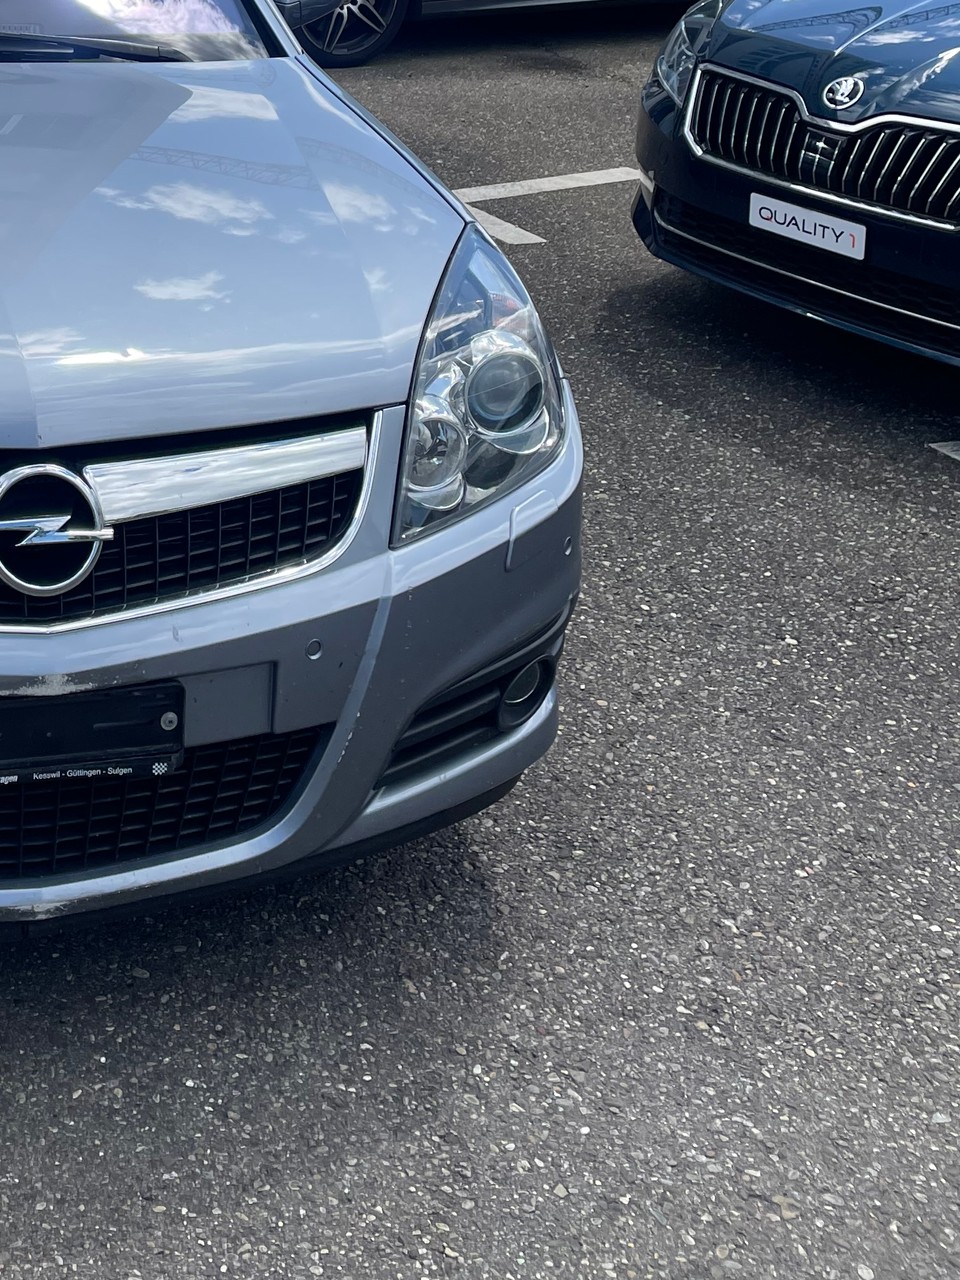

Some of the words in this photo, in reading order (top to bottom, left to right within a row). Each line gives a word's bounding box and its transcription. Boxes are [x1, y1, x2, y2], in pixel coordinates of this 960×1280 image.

[759, 206, 844, 243] QUALITY
[849, 233, 856, 248] 1
[33, 771, 60, 780] Kesswil
[107, 766, 133, 776] Sulgen
